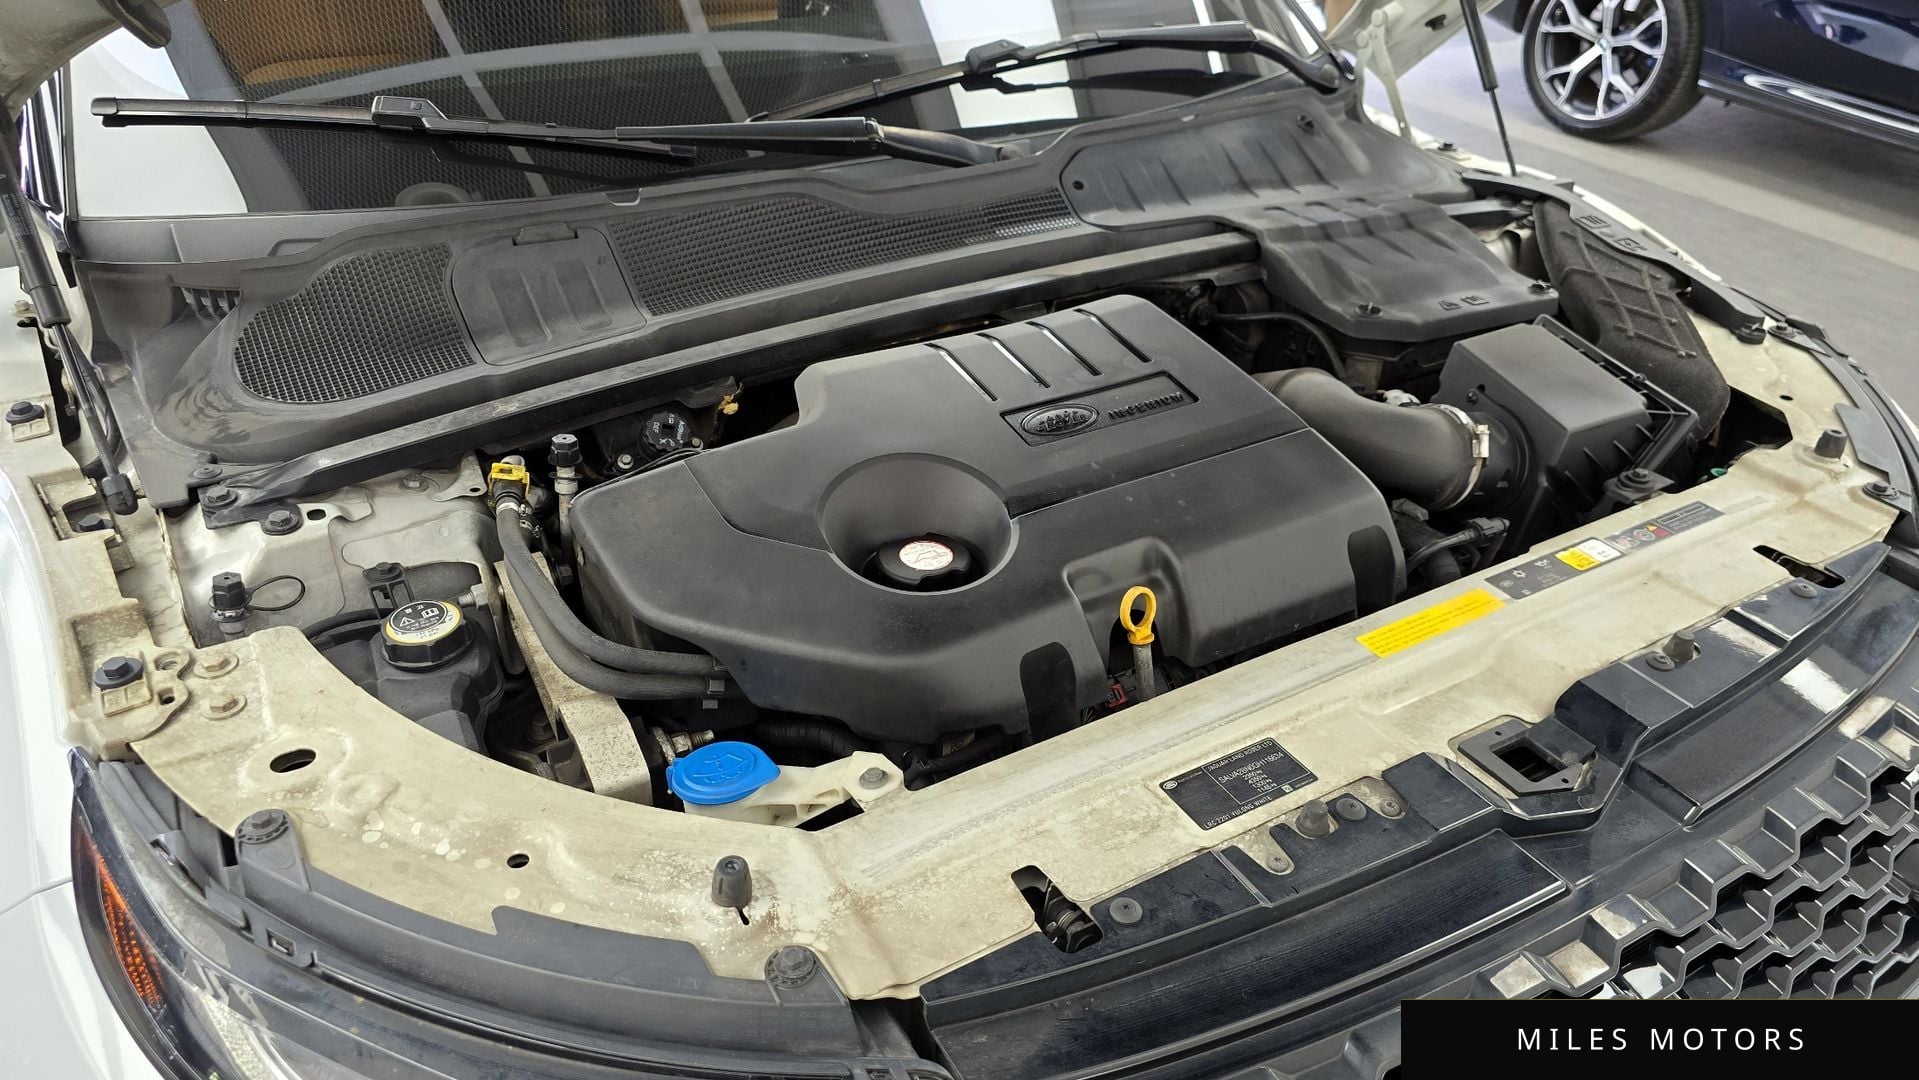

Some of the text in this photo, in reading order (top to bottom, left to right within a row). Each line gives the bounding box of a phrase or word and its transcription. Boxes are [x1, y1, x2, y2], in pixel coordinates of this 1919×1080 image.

[1229, 751, 1245, 763] LAND
[1243, 743, 1263, 756] ROVER
[1261, 740, 1273, 748] LTD
